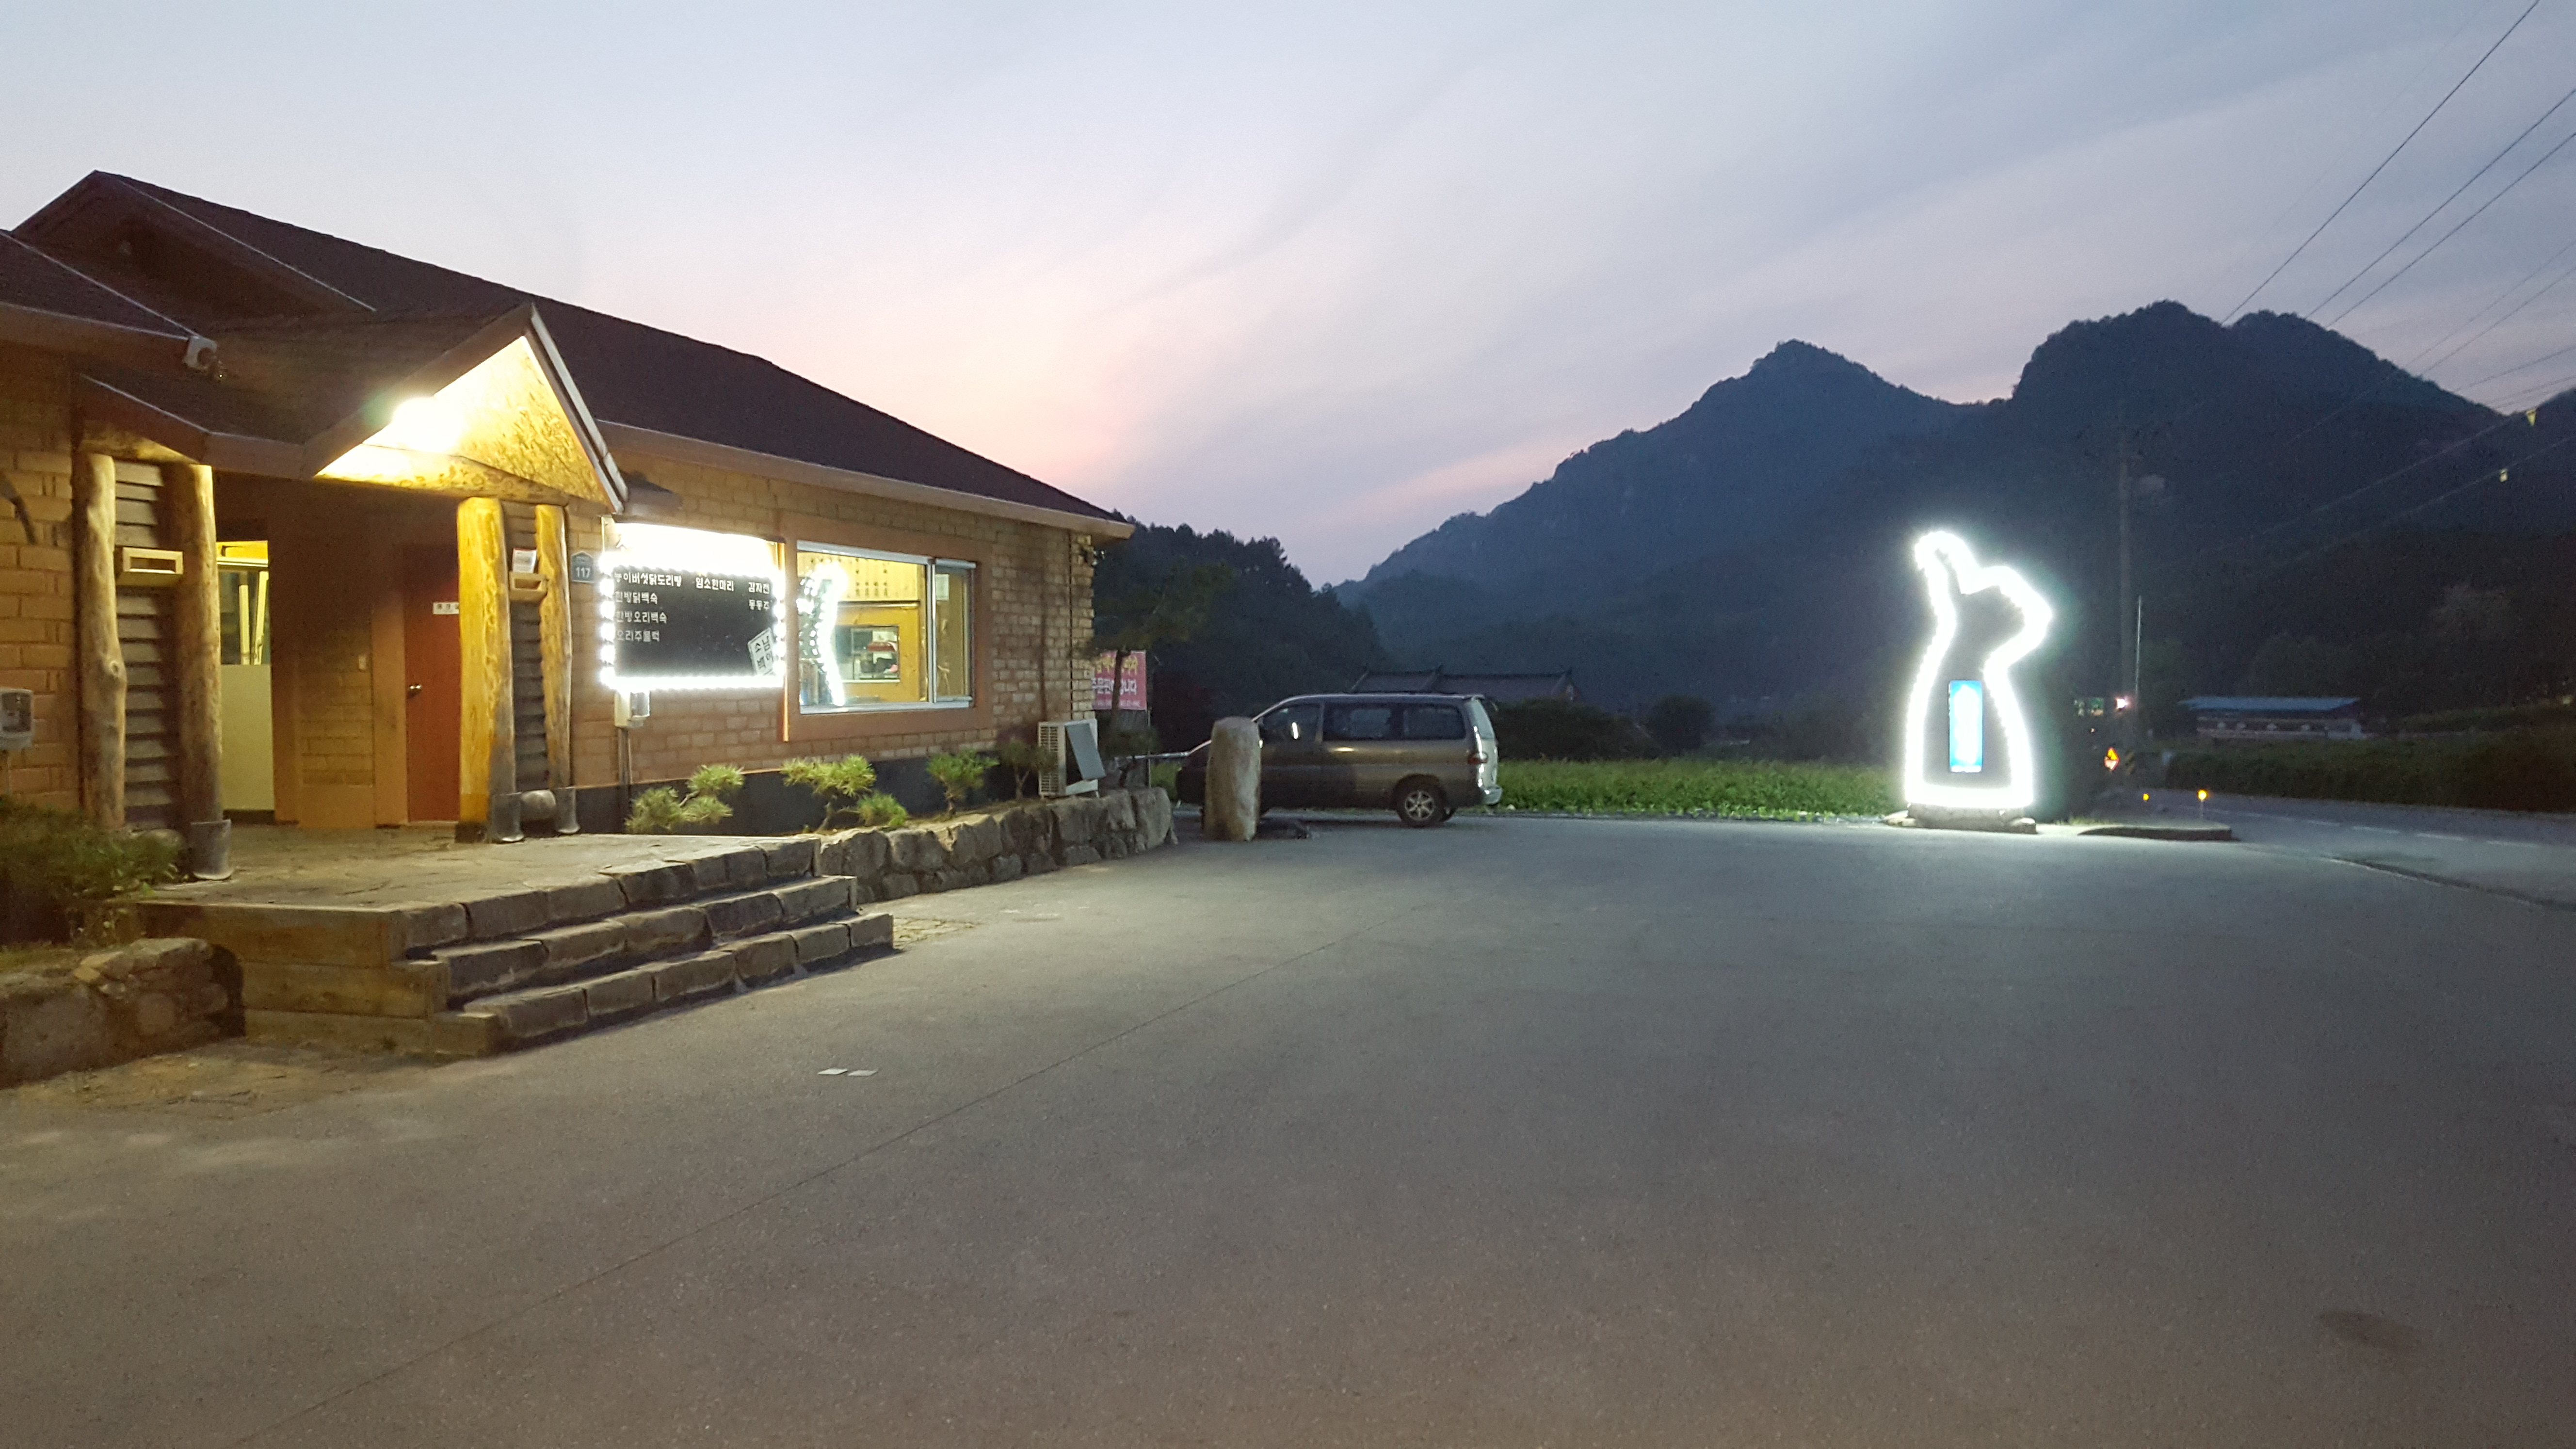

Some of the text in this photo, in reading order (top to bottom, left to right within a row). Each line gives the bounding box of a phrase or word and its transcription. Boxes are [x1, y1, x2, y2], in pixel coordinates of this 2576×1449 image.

[576, 566, 591, 578] 117
[695, 577, 734, 592] 염소한마리
[614, 591, 658, 605] 한방닭백숙
[748, 599, 770, 611] 동동주
[615, 610, 667, 624] 한방오리백숙
[616, 629, 660, 643] 오리주물럭
